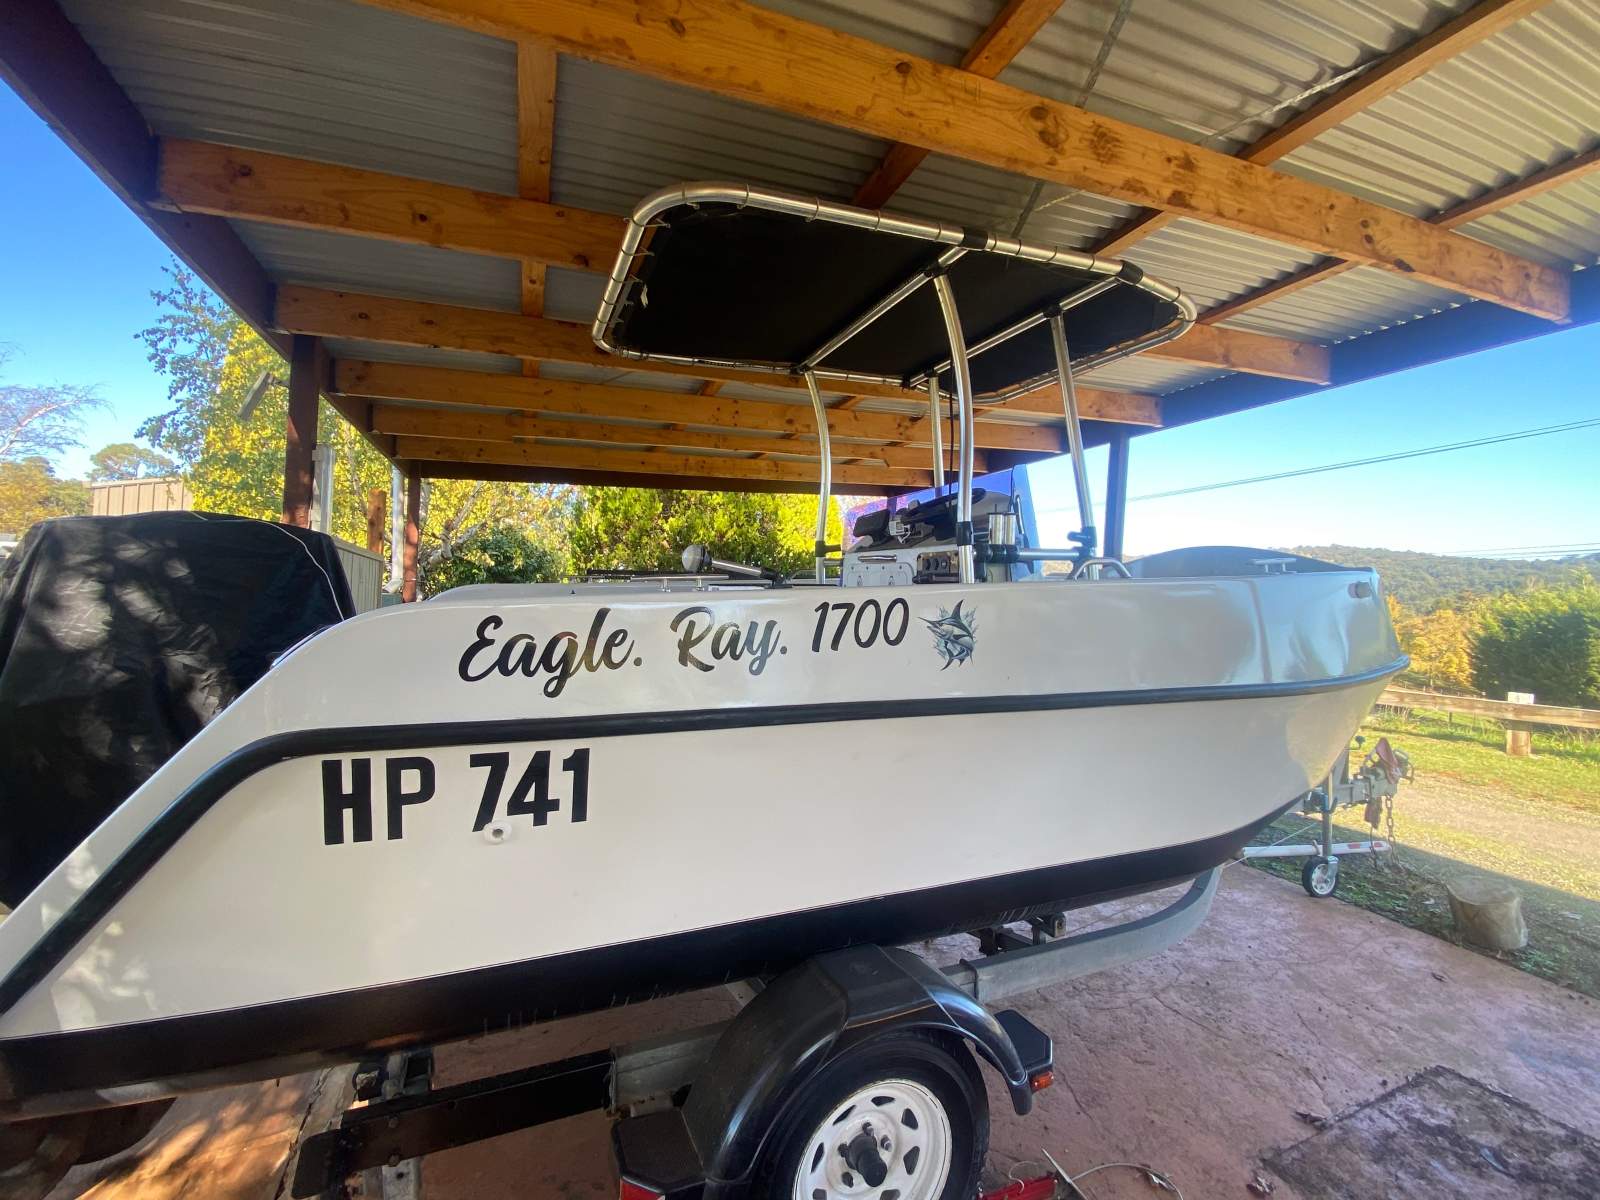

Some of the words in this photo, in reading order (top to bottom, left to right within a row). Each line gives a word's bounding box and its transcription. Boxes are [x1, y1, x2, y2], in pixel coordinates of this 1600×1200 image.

[459, 608, 643, 698] Eagle.
[670, 606, 788, 676] Ray.
[812, 597, 909, 653] 1700
[321, 757, 435, 846] HP
[469, 747, 590, 834] 741
